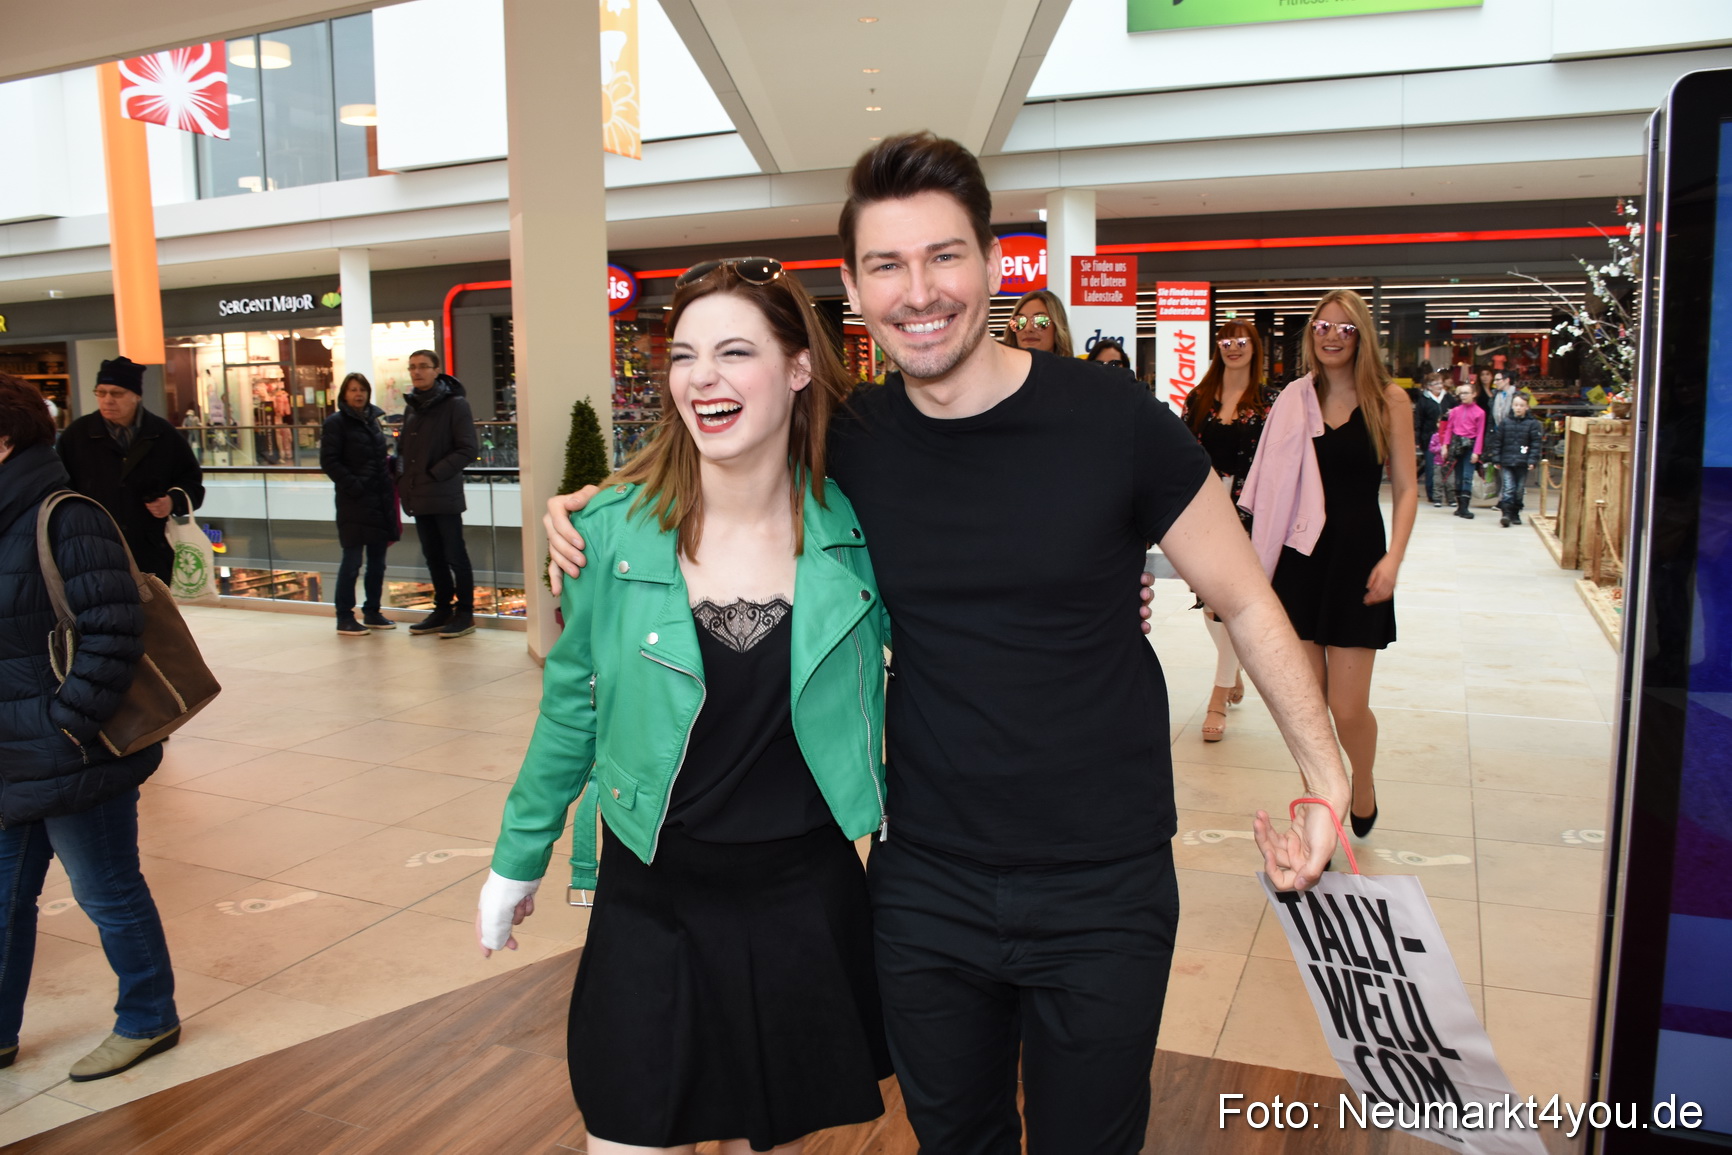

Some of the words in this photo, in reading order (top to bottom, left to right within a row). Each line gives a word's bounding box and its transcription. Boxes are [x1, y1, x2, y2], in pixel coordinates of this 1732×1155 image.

[1001, 248, 1046, 282] ervi
[1080, 260, 1091, 272] Sie
[1092, 260, 1114, 272] finden
[1114, 262, 1127, 272] uns
[1081, 275, 1088, 287] in
[1089, 275, 1100, 287] der
[1100, 272, 1127, 287] Unteren
[608, 276, 630, 299] is
[1157, 288, 1169, 297] Sie
[1169, 287, 1194, 297] finden
[1194, 289, 1208, 297] uns
[1084, 290, 1124, 302] Ladenstraße
[1158, 297, 1167, 306] in
[1167, 297, 1180, 306] der
[1180, 297, 1207, 306] Oberen
[1159, 306, 1206, 316] Ladenstraße
[1169, 329, 1196, 409] Markt
[1275, 890, 1427, 977] TALLY-
